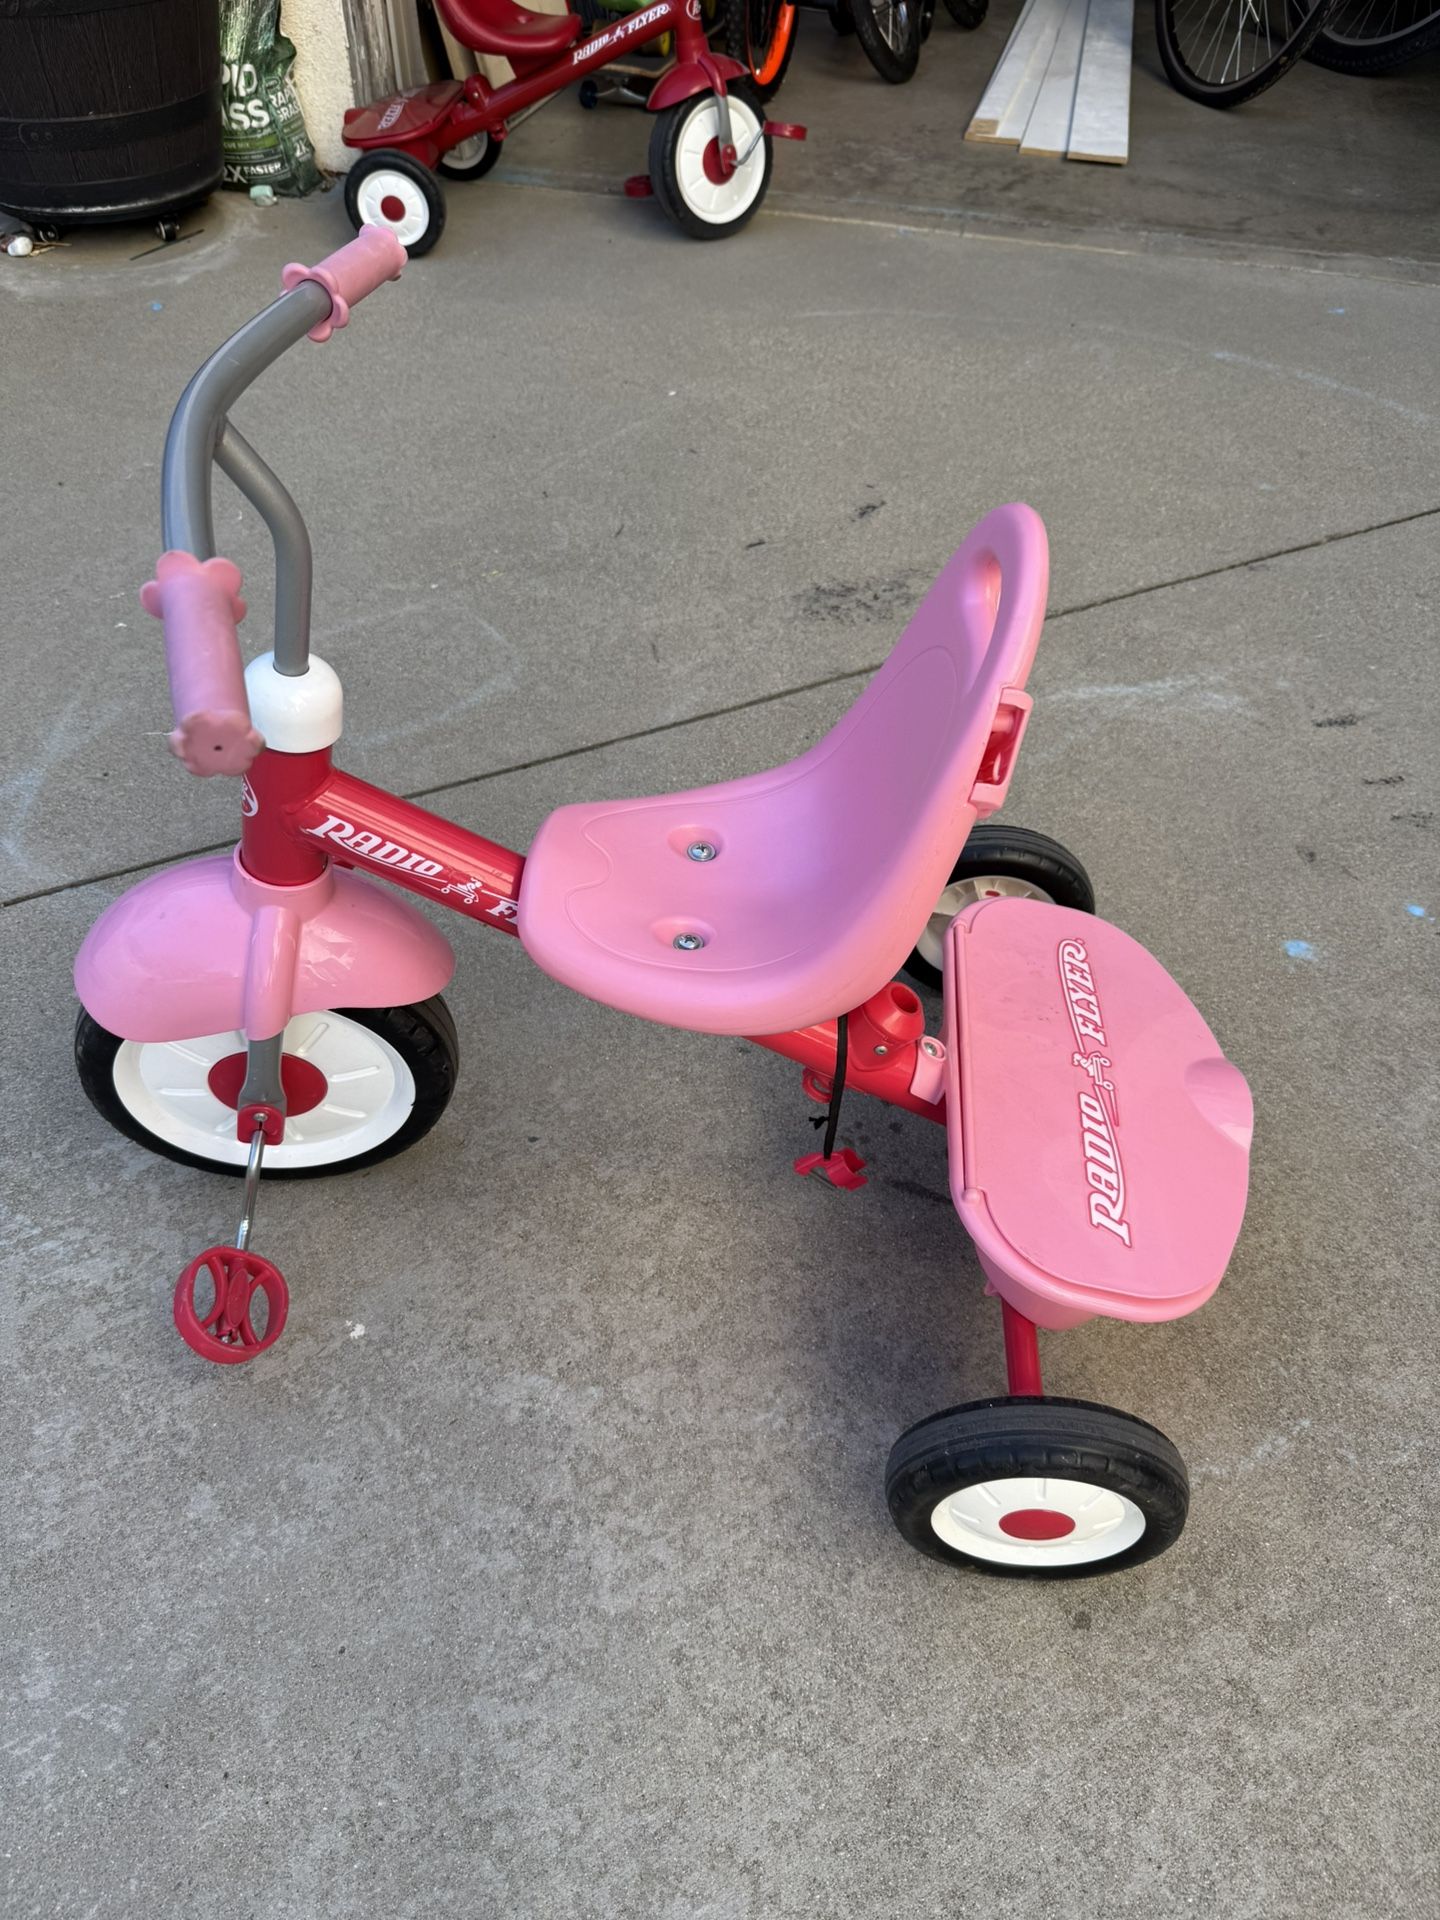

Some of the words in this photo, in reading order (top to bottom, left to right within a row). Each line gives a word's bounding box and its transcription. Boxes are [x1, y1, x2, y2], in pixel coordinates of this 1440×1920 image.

[573, 33, 609, 65] RADIO
[627, 3, 669, 34] FLYER
[243, 161, 281, 175] FASTER
[305, 814, 445, 878] RADIO
[1058, 939, 1107, 1047] FLYER
[1078, 1091, 1132, 1248] RADIO
